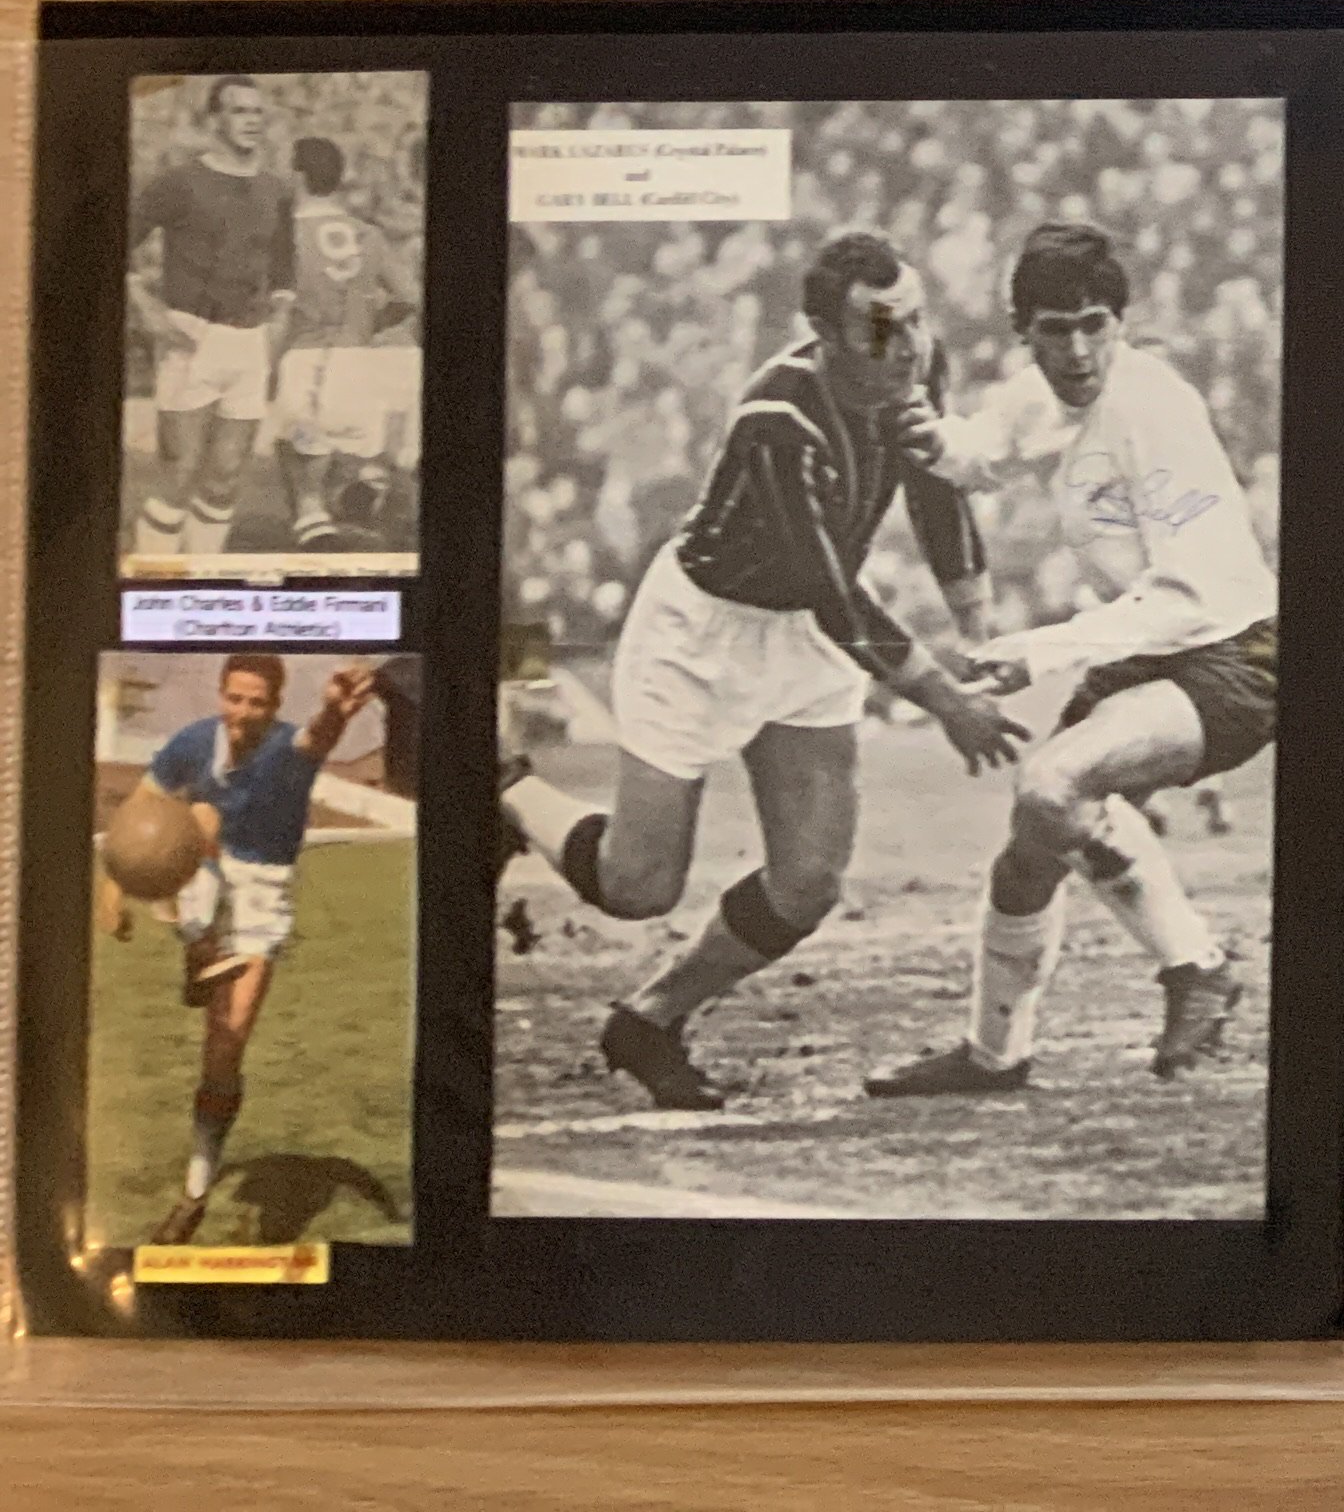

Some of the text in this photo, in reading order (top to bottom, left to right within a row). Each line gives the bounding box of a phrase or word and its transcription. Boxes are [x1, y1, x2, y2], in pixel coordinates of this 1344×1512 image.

[316, 220, 363, 282] 9
[132, 596, 175, 611] John
[179, 595, 246, 612] Charles
[251, 596, 263, 612] &
[269, 595, 318, 612] Eddie
